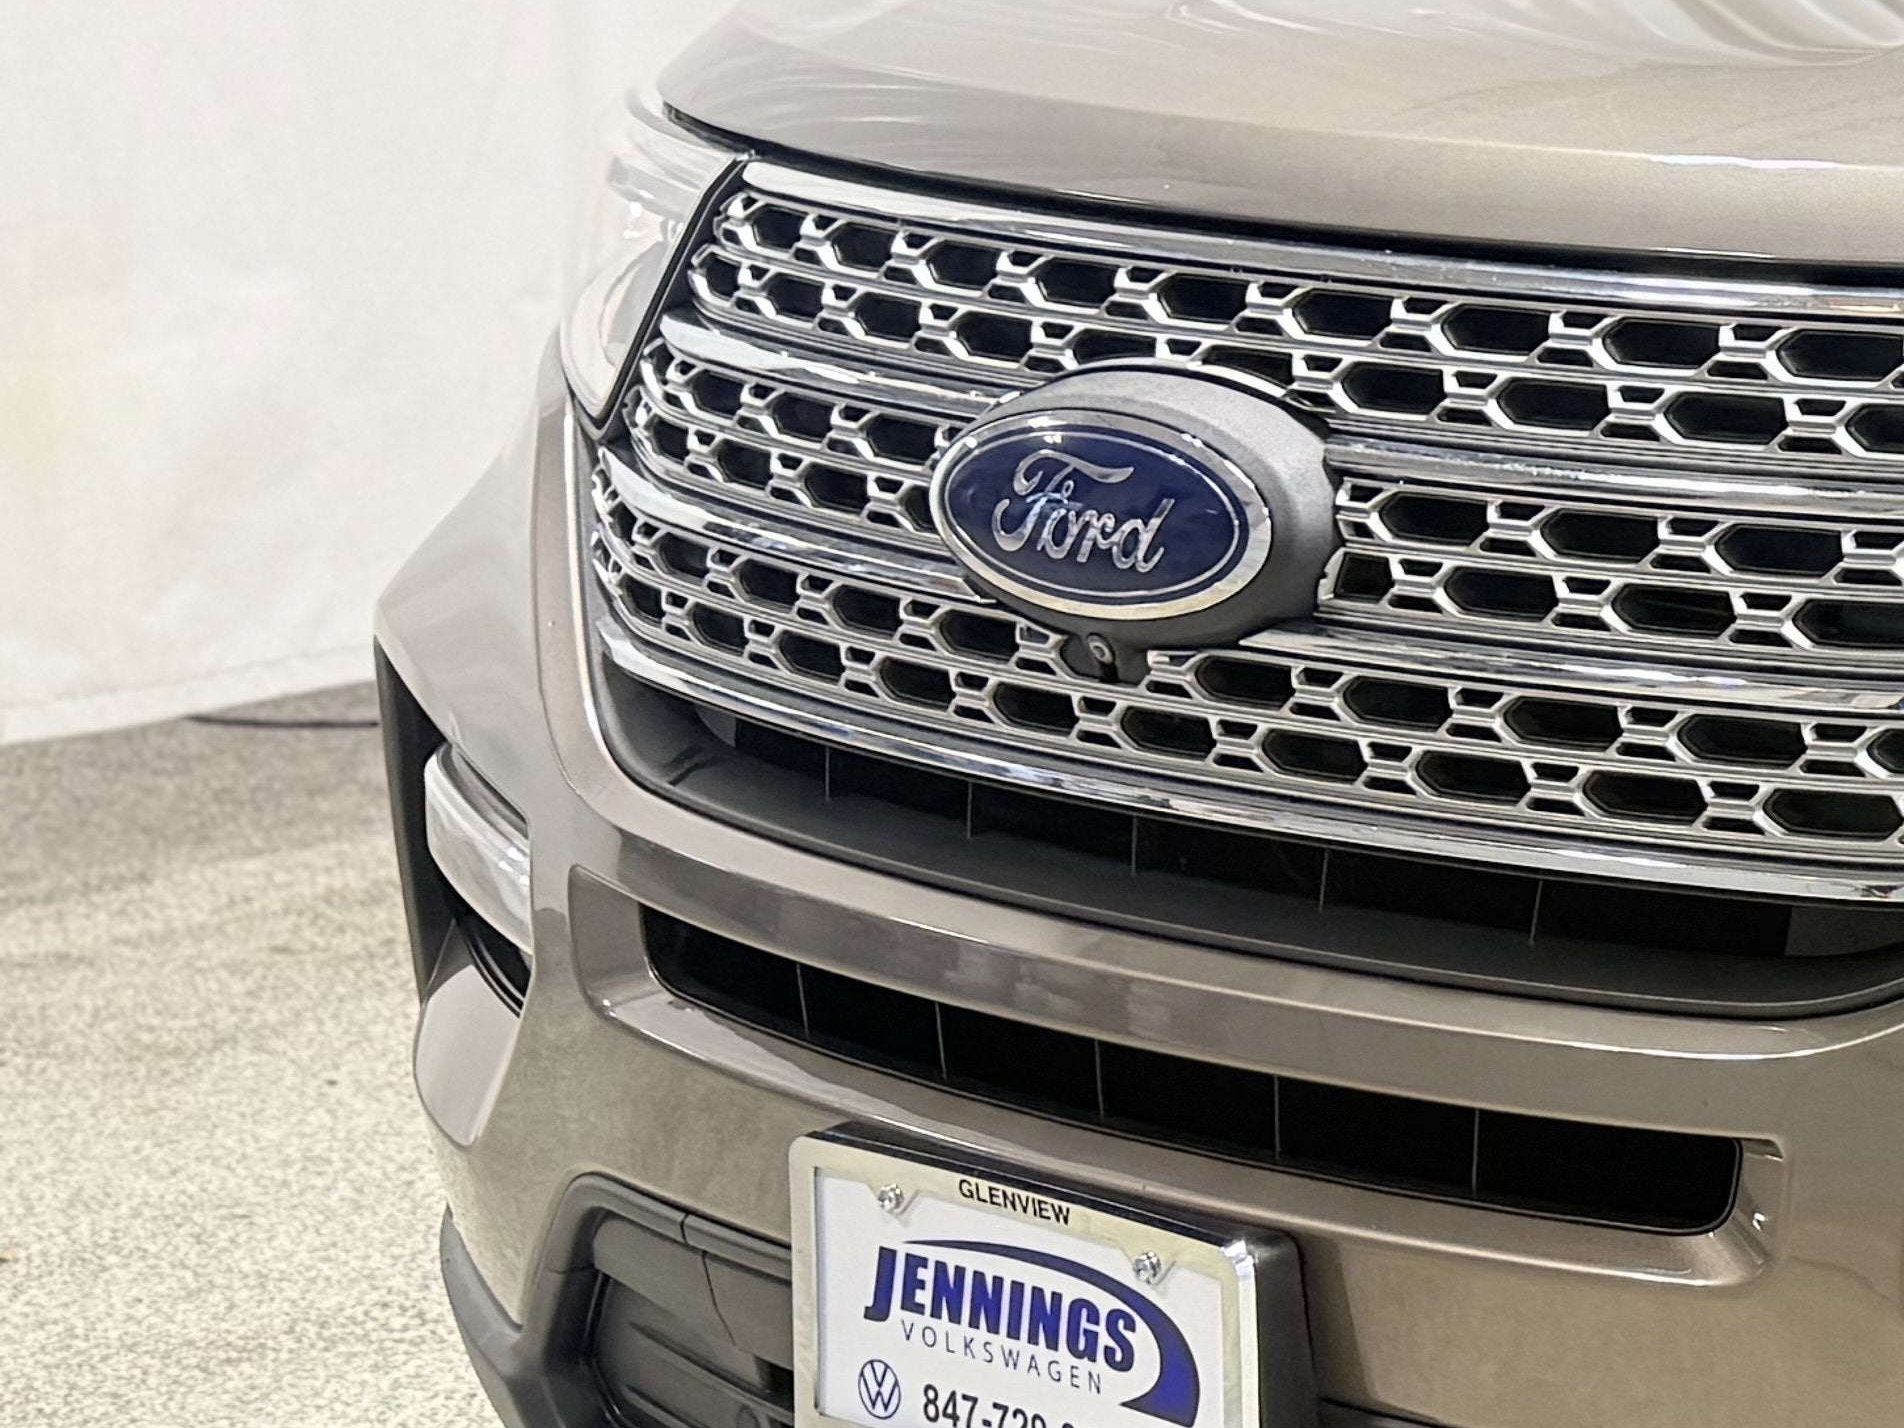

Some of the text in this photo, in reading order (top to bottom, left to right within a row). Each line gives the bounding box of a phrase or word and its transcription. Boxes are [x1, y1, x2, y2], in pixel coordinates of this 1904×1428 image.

[991, 449, 1175, 573] Ford
[958, 1178, 1071, 1226] GLENVIEW
[863, 1246, 1137, 1373] JENNINGS
[901, 1319, 1102, 1395] VOLKSWAGEN
